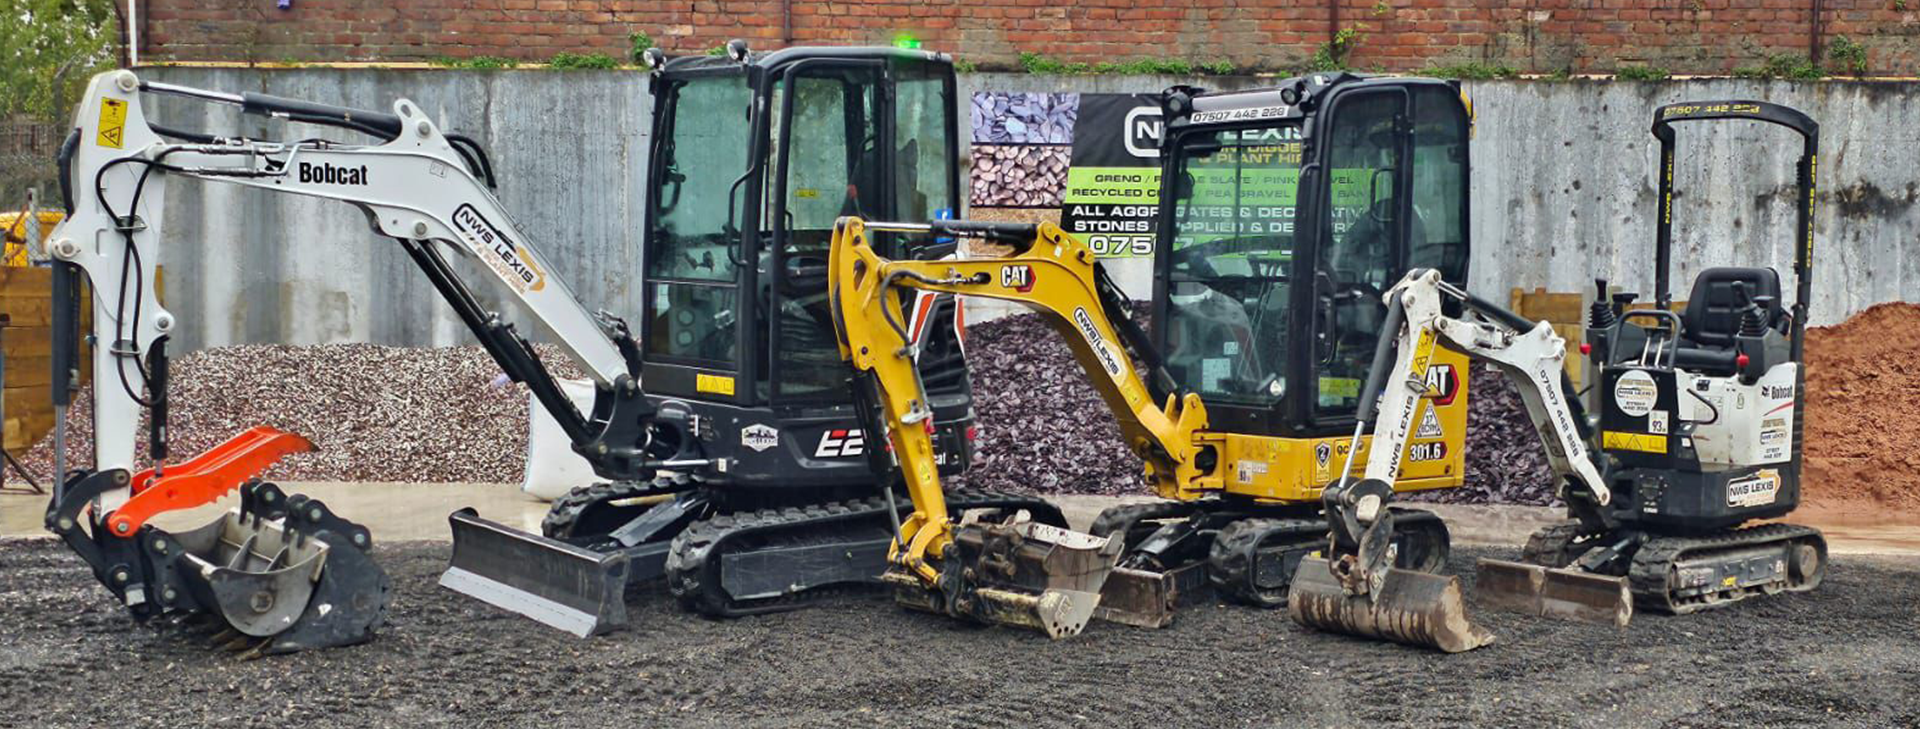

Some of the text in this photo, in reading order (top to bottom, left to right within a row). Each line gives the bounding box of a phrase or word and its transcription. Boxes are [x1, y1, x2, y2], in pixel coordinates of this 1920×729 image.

[1193, 107, 1286, 123] 07507 442 228
[1217, 153, 1274, 164] PLANT
[298, 161, 368, 186] Bobcat
[1094, 174, 1142, 184] GRENO
[1263, 176, 1297, 185] PINK
[1071, 188, 1143, 198] RECYCLED
[1071, 205, 1106, 216] ALL
[1240, 206, 1252, 218] &
[1074, 220, 1150, 232] STONES
[1250, 221, 1263, 233] &
[460, 210, 535, 283] NWS LEXIS
[1001, 264, 1029, 288] CAT
[1076, 312, 1120, 375] NWS LEXIS
[1426, 365, 1450, 396] AT
[1540, 369, 1559, 406] 07507
[1771, 385, 1794, 400] Bobcat
[1652, 420, 1662, 432] 93
[814, 429, 867, 457] E2
[1388, 395, 1414, 478] NWS LEXIS
[1409, 442, 1441, 461] 301.6
[1730, 480, 1774, 497] NWS LEXIS
